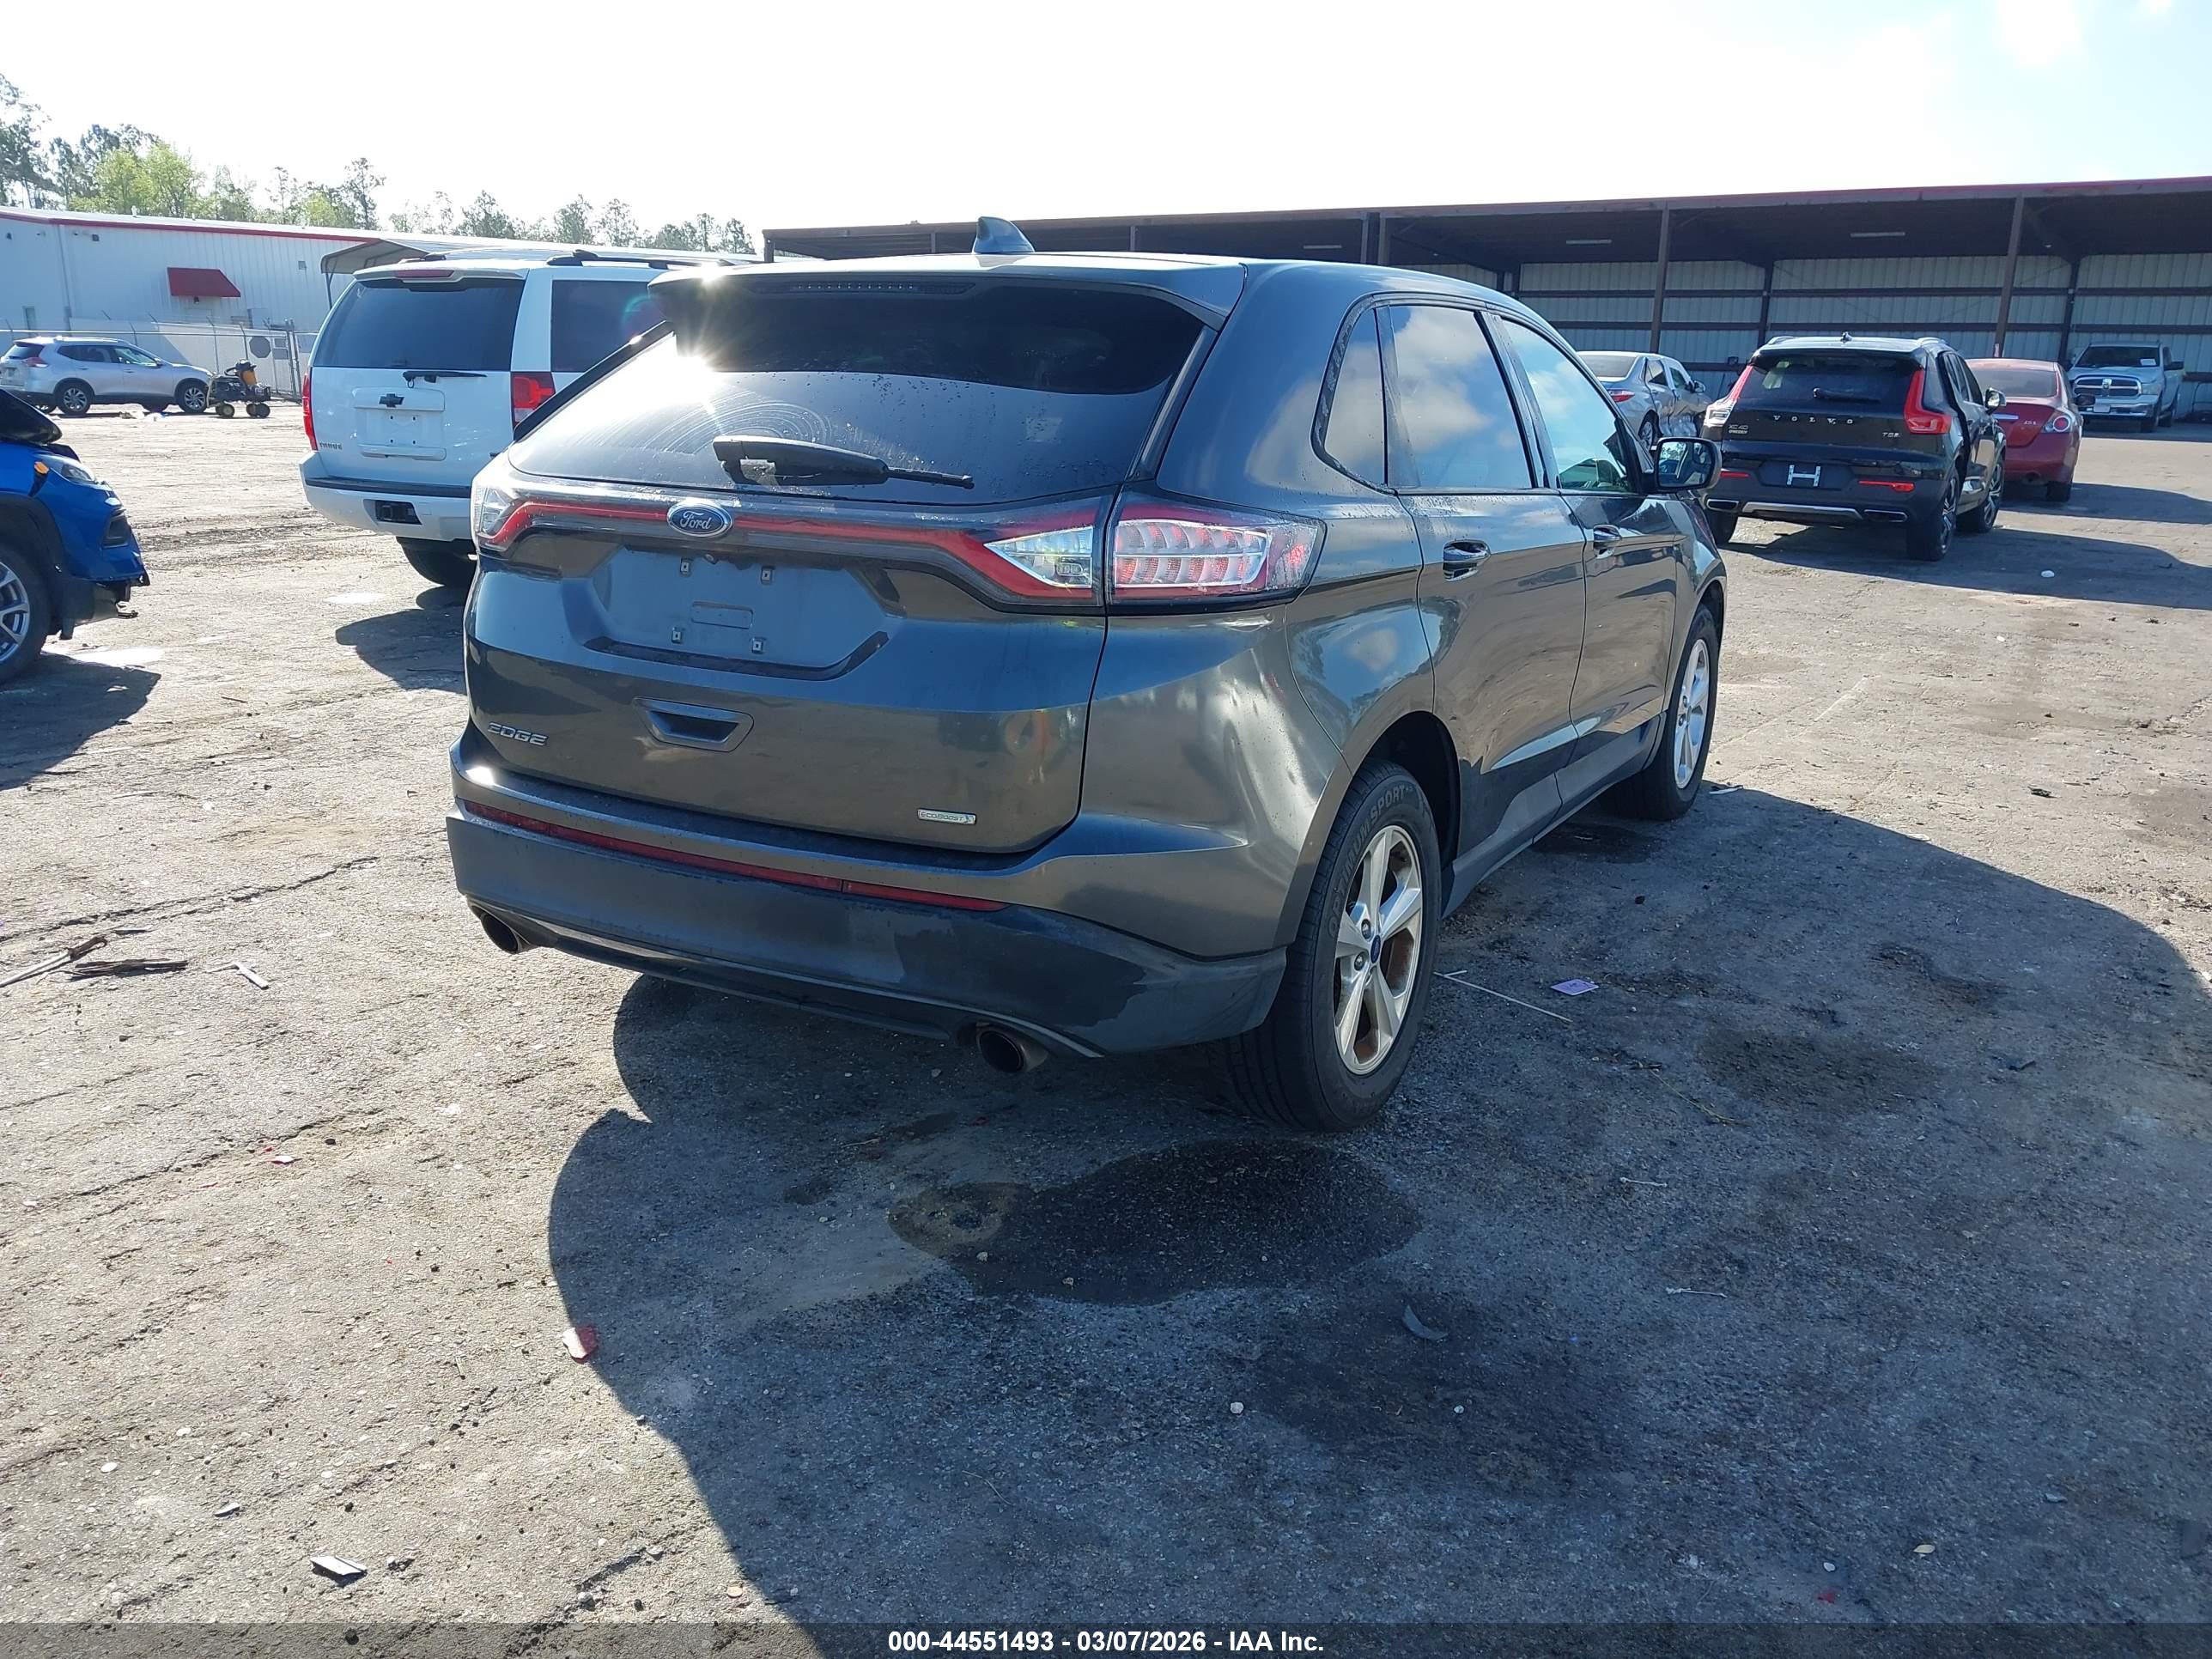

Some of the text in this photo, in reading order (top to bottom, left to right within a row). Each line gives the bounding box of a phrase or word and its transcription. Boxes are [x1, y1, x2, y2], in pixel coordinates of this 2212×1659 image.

[1772, 415, 1854, 425] VOLVO
[679, 510, 713, 530] Ford
[487, 721, 548, 746] EDGE
[1370, 783, 1406, 821] SPORT
